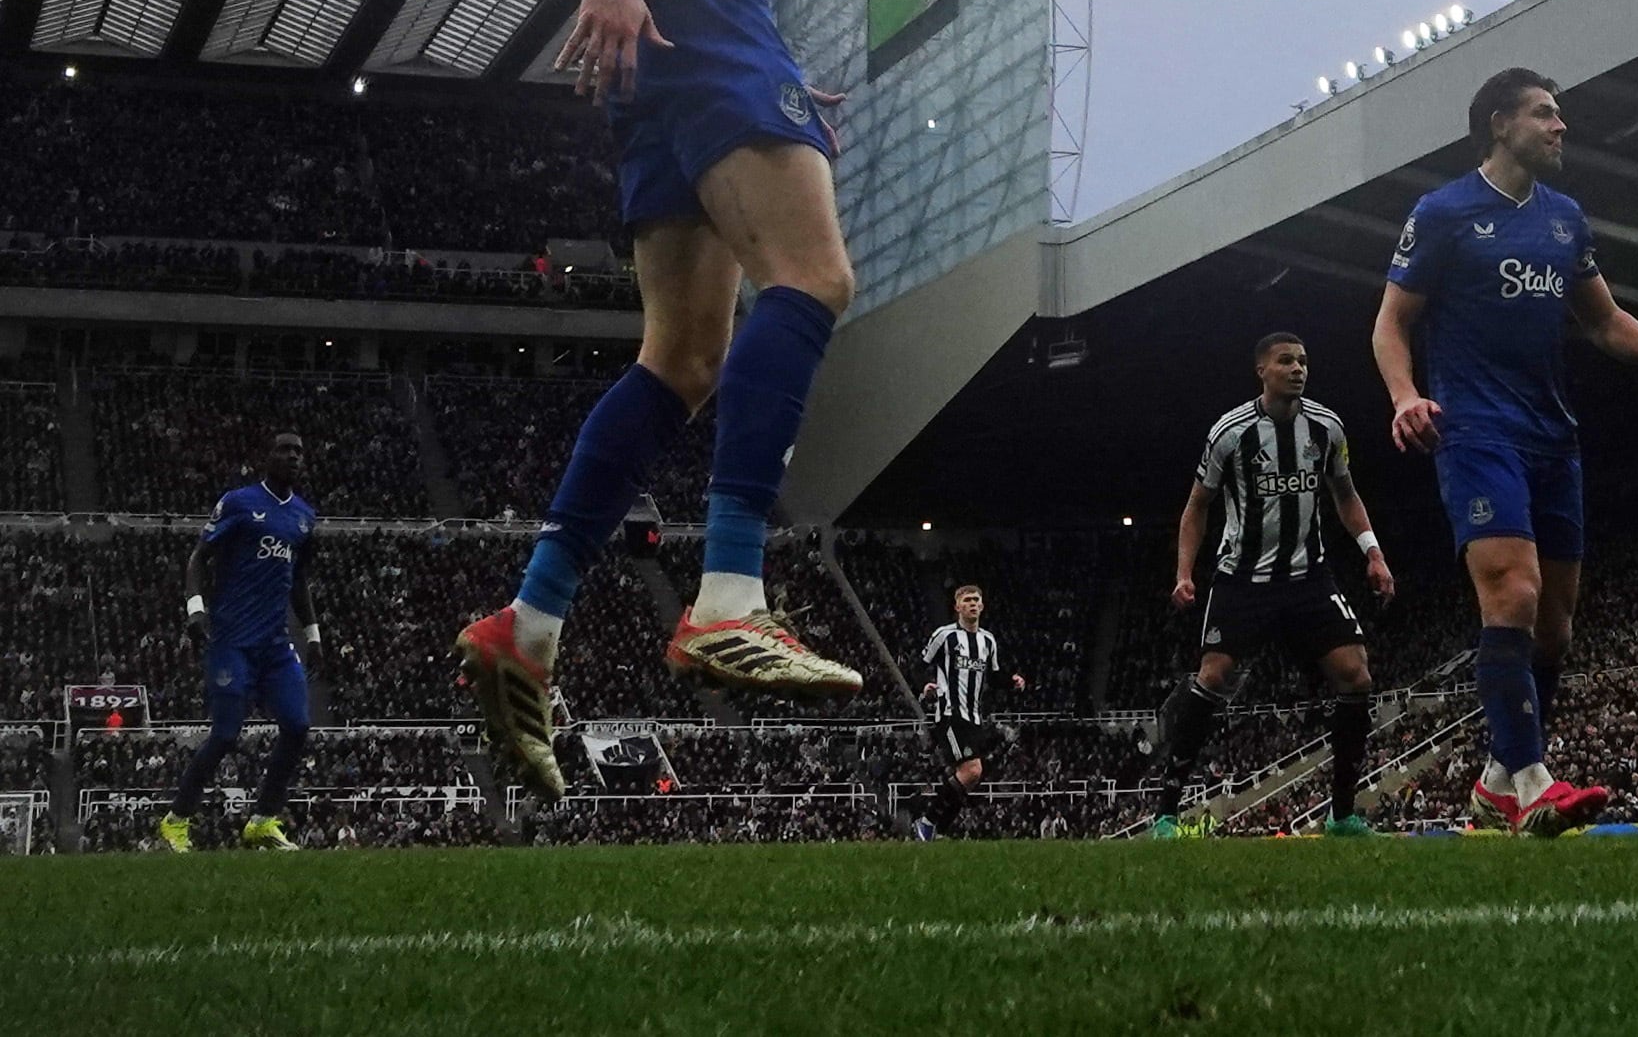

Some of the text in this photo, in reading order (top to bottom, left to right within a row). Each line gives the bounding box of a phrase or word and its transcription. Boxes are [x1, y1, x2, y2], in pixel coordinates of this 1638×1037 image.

[1499, 258, 1564, 299] Stake
[1277, 470, 1319, 493] sela
[75, 695, 138, 709] 1892
